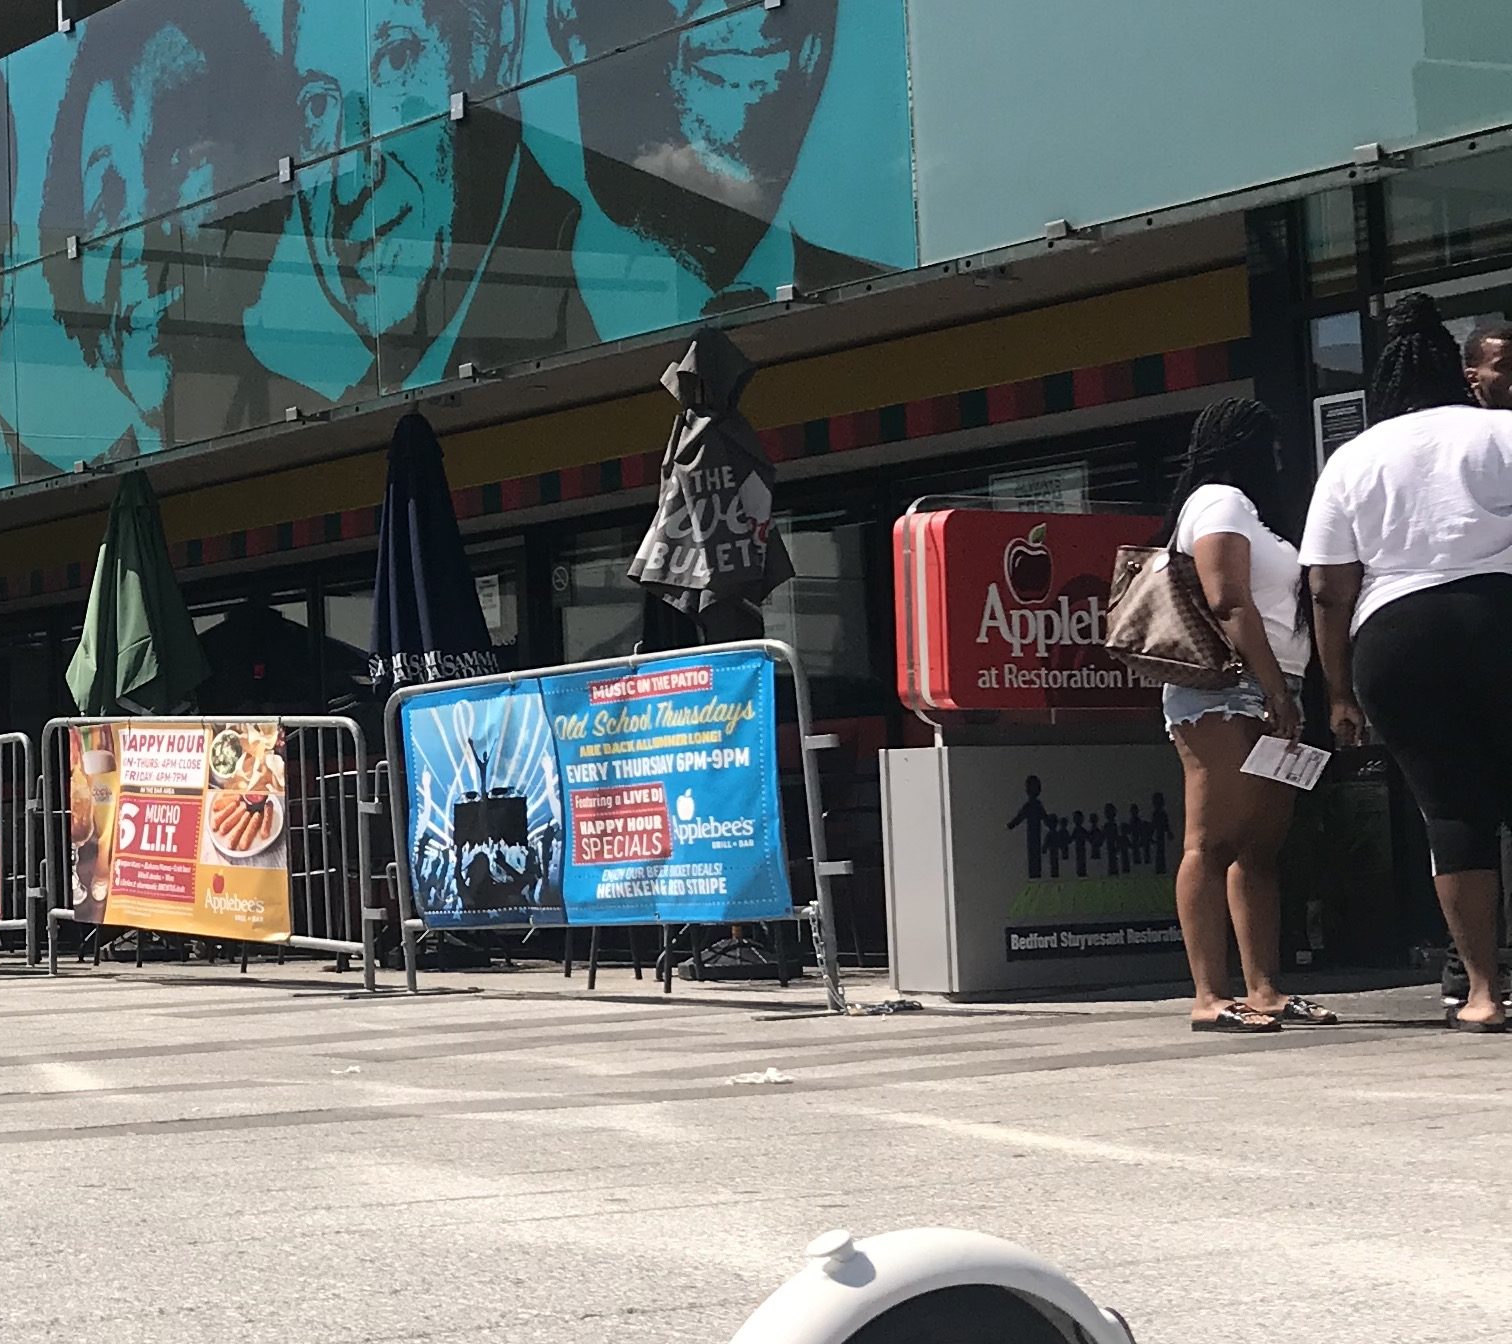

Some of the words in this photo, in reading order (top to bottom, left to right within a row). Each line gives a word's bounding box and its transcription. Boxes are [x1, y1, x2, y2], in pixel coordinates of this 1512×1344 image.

[691, 465, 736, 493] THE
[976, 582, 1107, 657] Appleb
[592, 680, 636, 700] MUSIC
[651, 675, 670, 692] THE
[671, 670, 708, 689] PATIO
[977, 665, 998, 689] at
[1004, 664, 1123, 689] Restoration
[1128, 667, 1163, 688] Pla
[554, 712, 588, 741] Old
[655, 695, 755, 735] Thursdays
[166, 734, 206, 753] HOUR
[566, 761, 609, 784] EVERY
[677, 747, 750, 771] 6PM-9PM
[623, 788, 649, 804] LIVE
[651, 787, 663, 803] DJ
[144, 803, 181, 825] MUCHO
[580, 818, 624, 836] HAPPY
[627, 815, 663, 832] HOUR
[140, 823, 178, 853] L.I.T.
[672, 815, 756, 846] Applebee's
[581, 832, 663, 860] SPECIALS
[626, 866, 645, 880] OUR
[691, 862, 723, 876] DEALS!
[205, 887, 265, 915] Applebee's
[596, 879, 661, 899] HEINEKEN
[686, 877, 728, 896] STRIPE
[1010, 932, 1057, 950] Bedford
[1060, 929, 1125, 950] Stuyvesant
[1126, 925, 1185, 944] Restoratio
